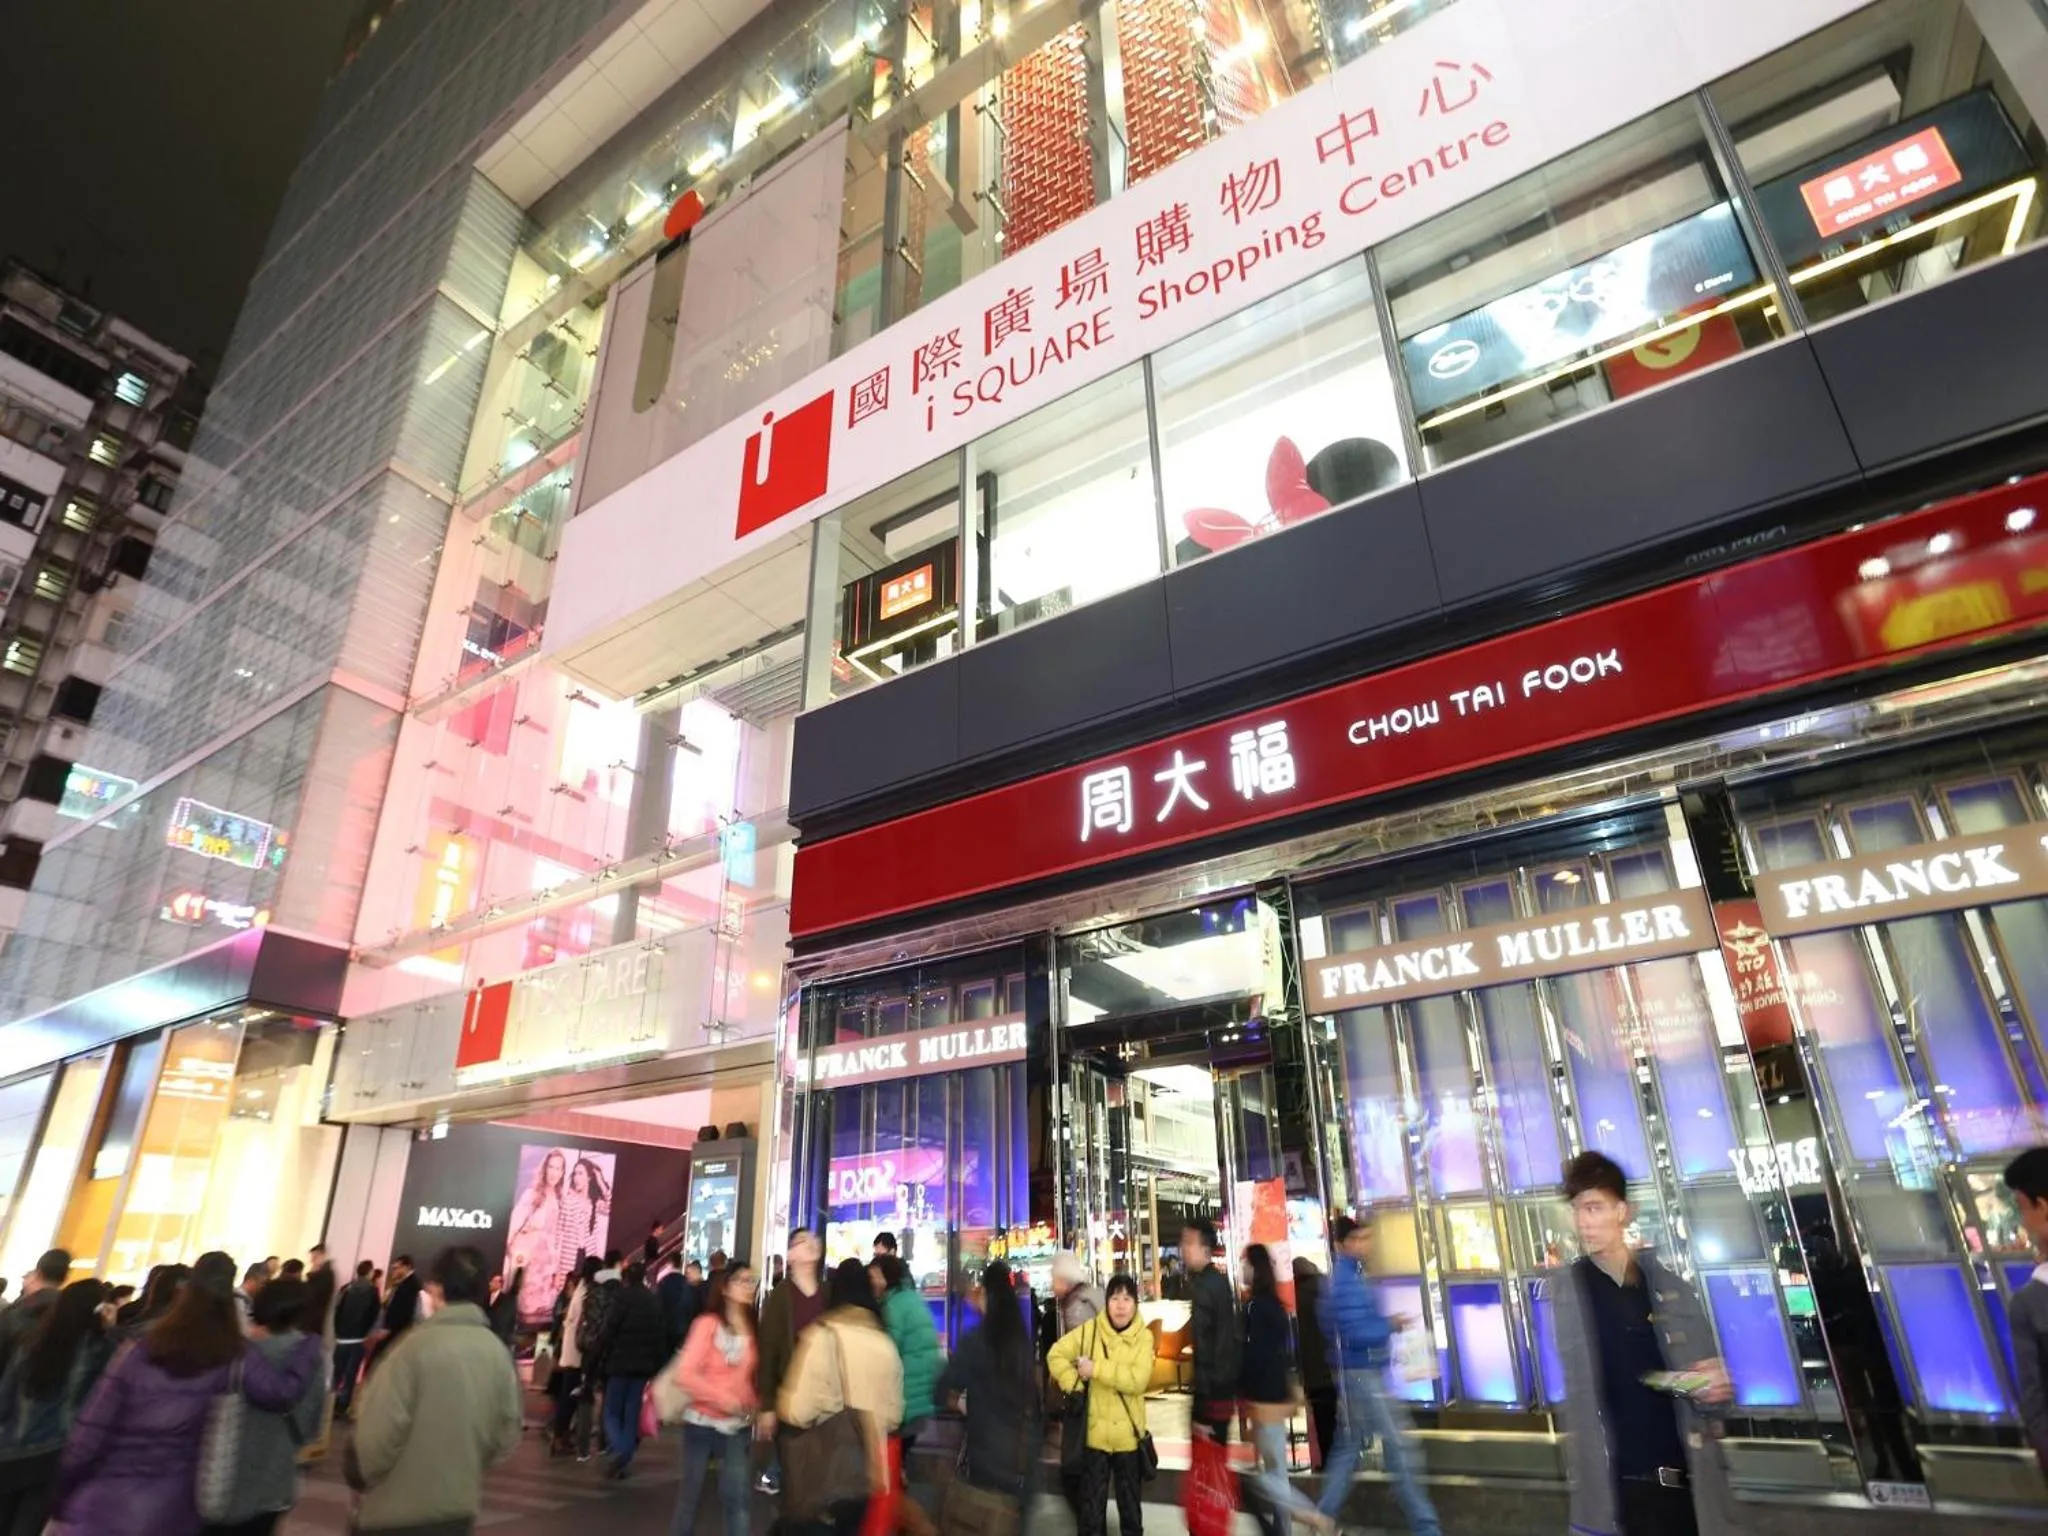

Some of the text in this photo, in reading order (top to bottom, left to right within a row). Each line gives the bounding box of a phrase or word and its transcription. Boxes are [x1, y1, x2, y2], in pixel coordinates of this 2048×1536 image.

[847, 60, 1493, 430] 國際廣場購物中心
[953, 307, 1115, 418] SQUARE
[1137, 210, 1327, 320] Shopping
[1339, 119, 1510, 216] Centre
[1347, 647, 1624, 746] CHOW TAI FOOK
[1080, 719, 1297, 843] 周大福
[1779, 842, 2021, 919] FRANCK
[1319, 903, 1691, 1000] FRANCK MULLER
[815, 1041, 908, 1081] FRANCK
[919, 1022, 1027, 1065] MULLER
